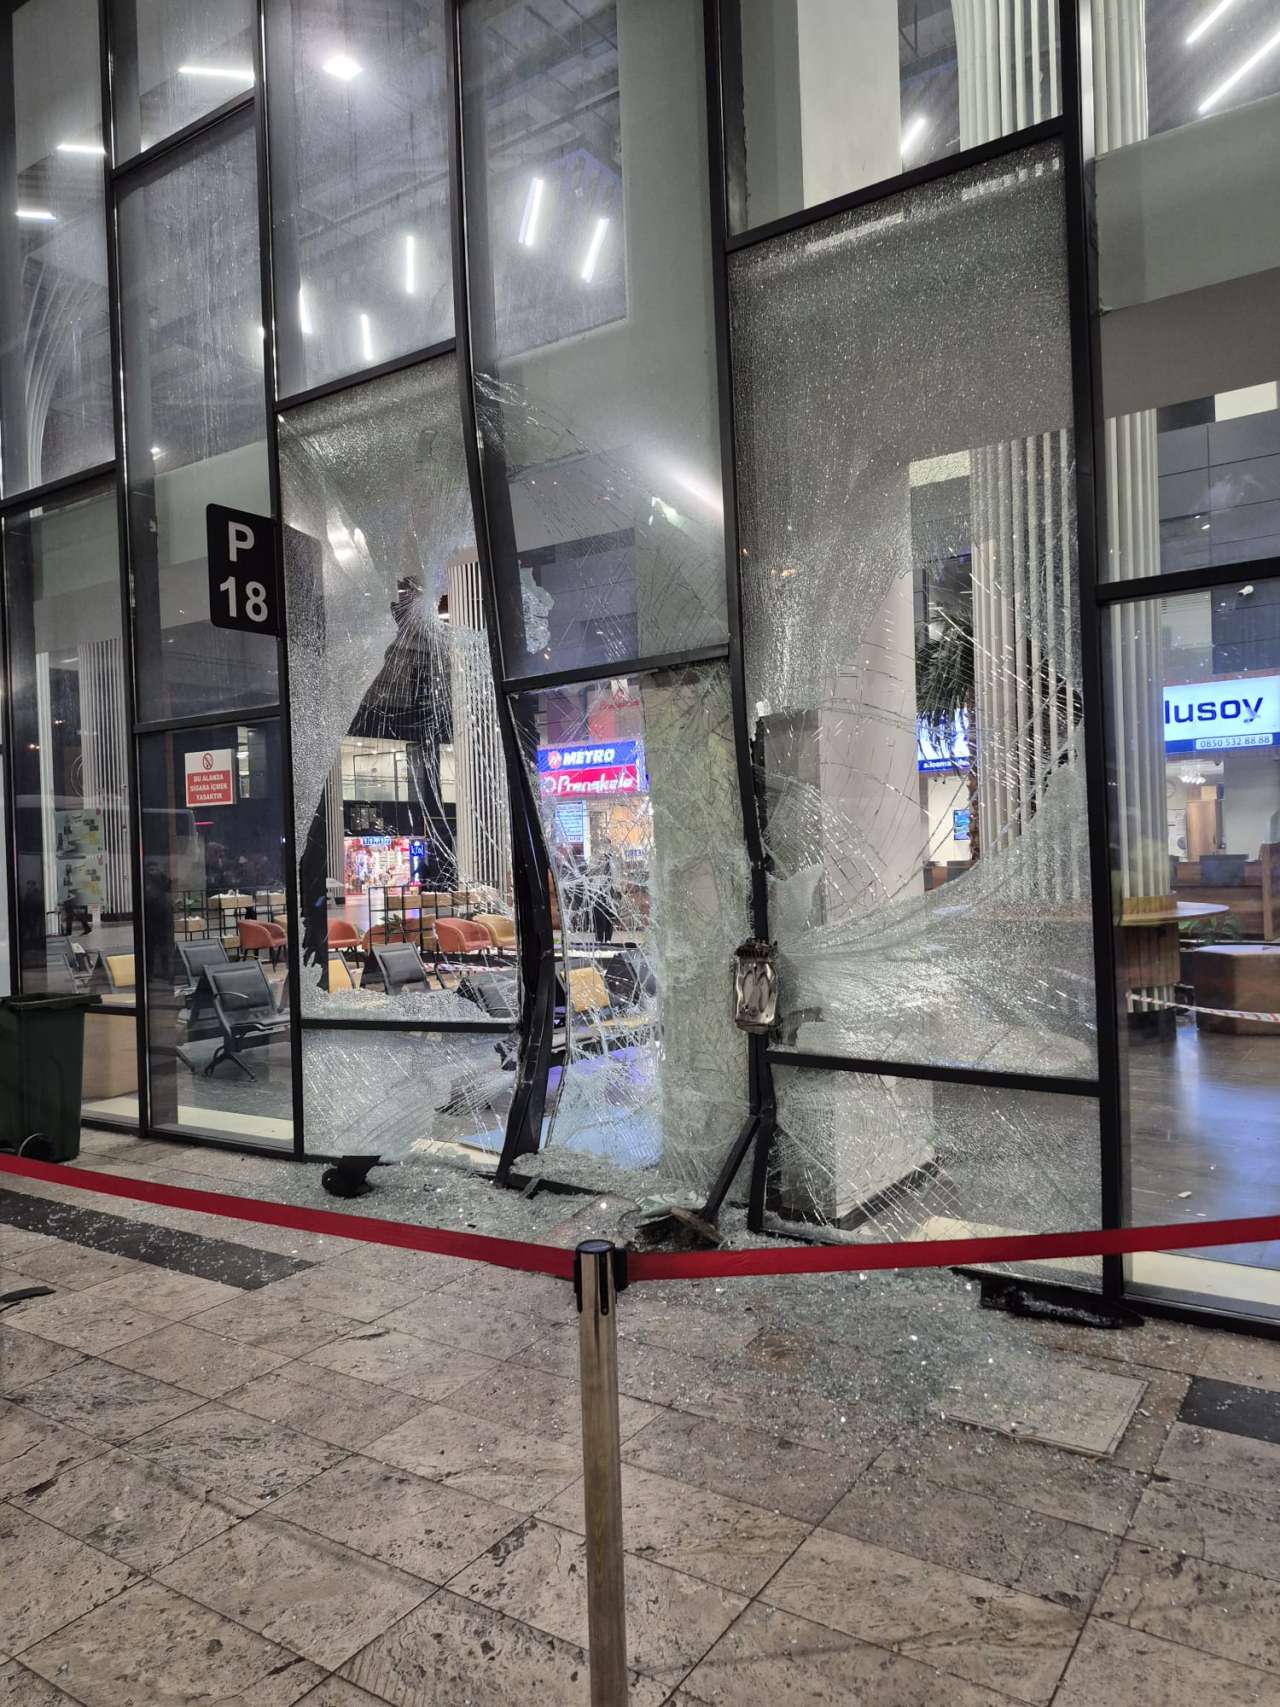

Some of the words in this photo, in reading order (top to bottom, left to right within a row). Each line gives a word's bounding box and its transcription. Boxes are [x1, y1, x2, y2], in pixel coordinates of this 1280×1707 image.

[228, 520, 255, 562] P
[219, 576, 268, 622] 18
[1164, 697, 1263, 724] lusoy
[1200, 739, 1223, 748] 0850
[1226, 737, 1241, 746] 532
